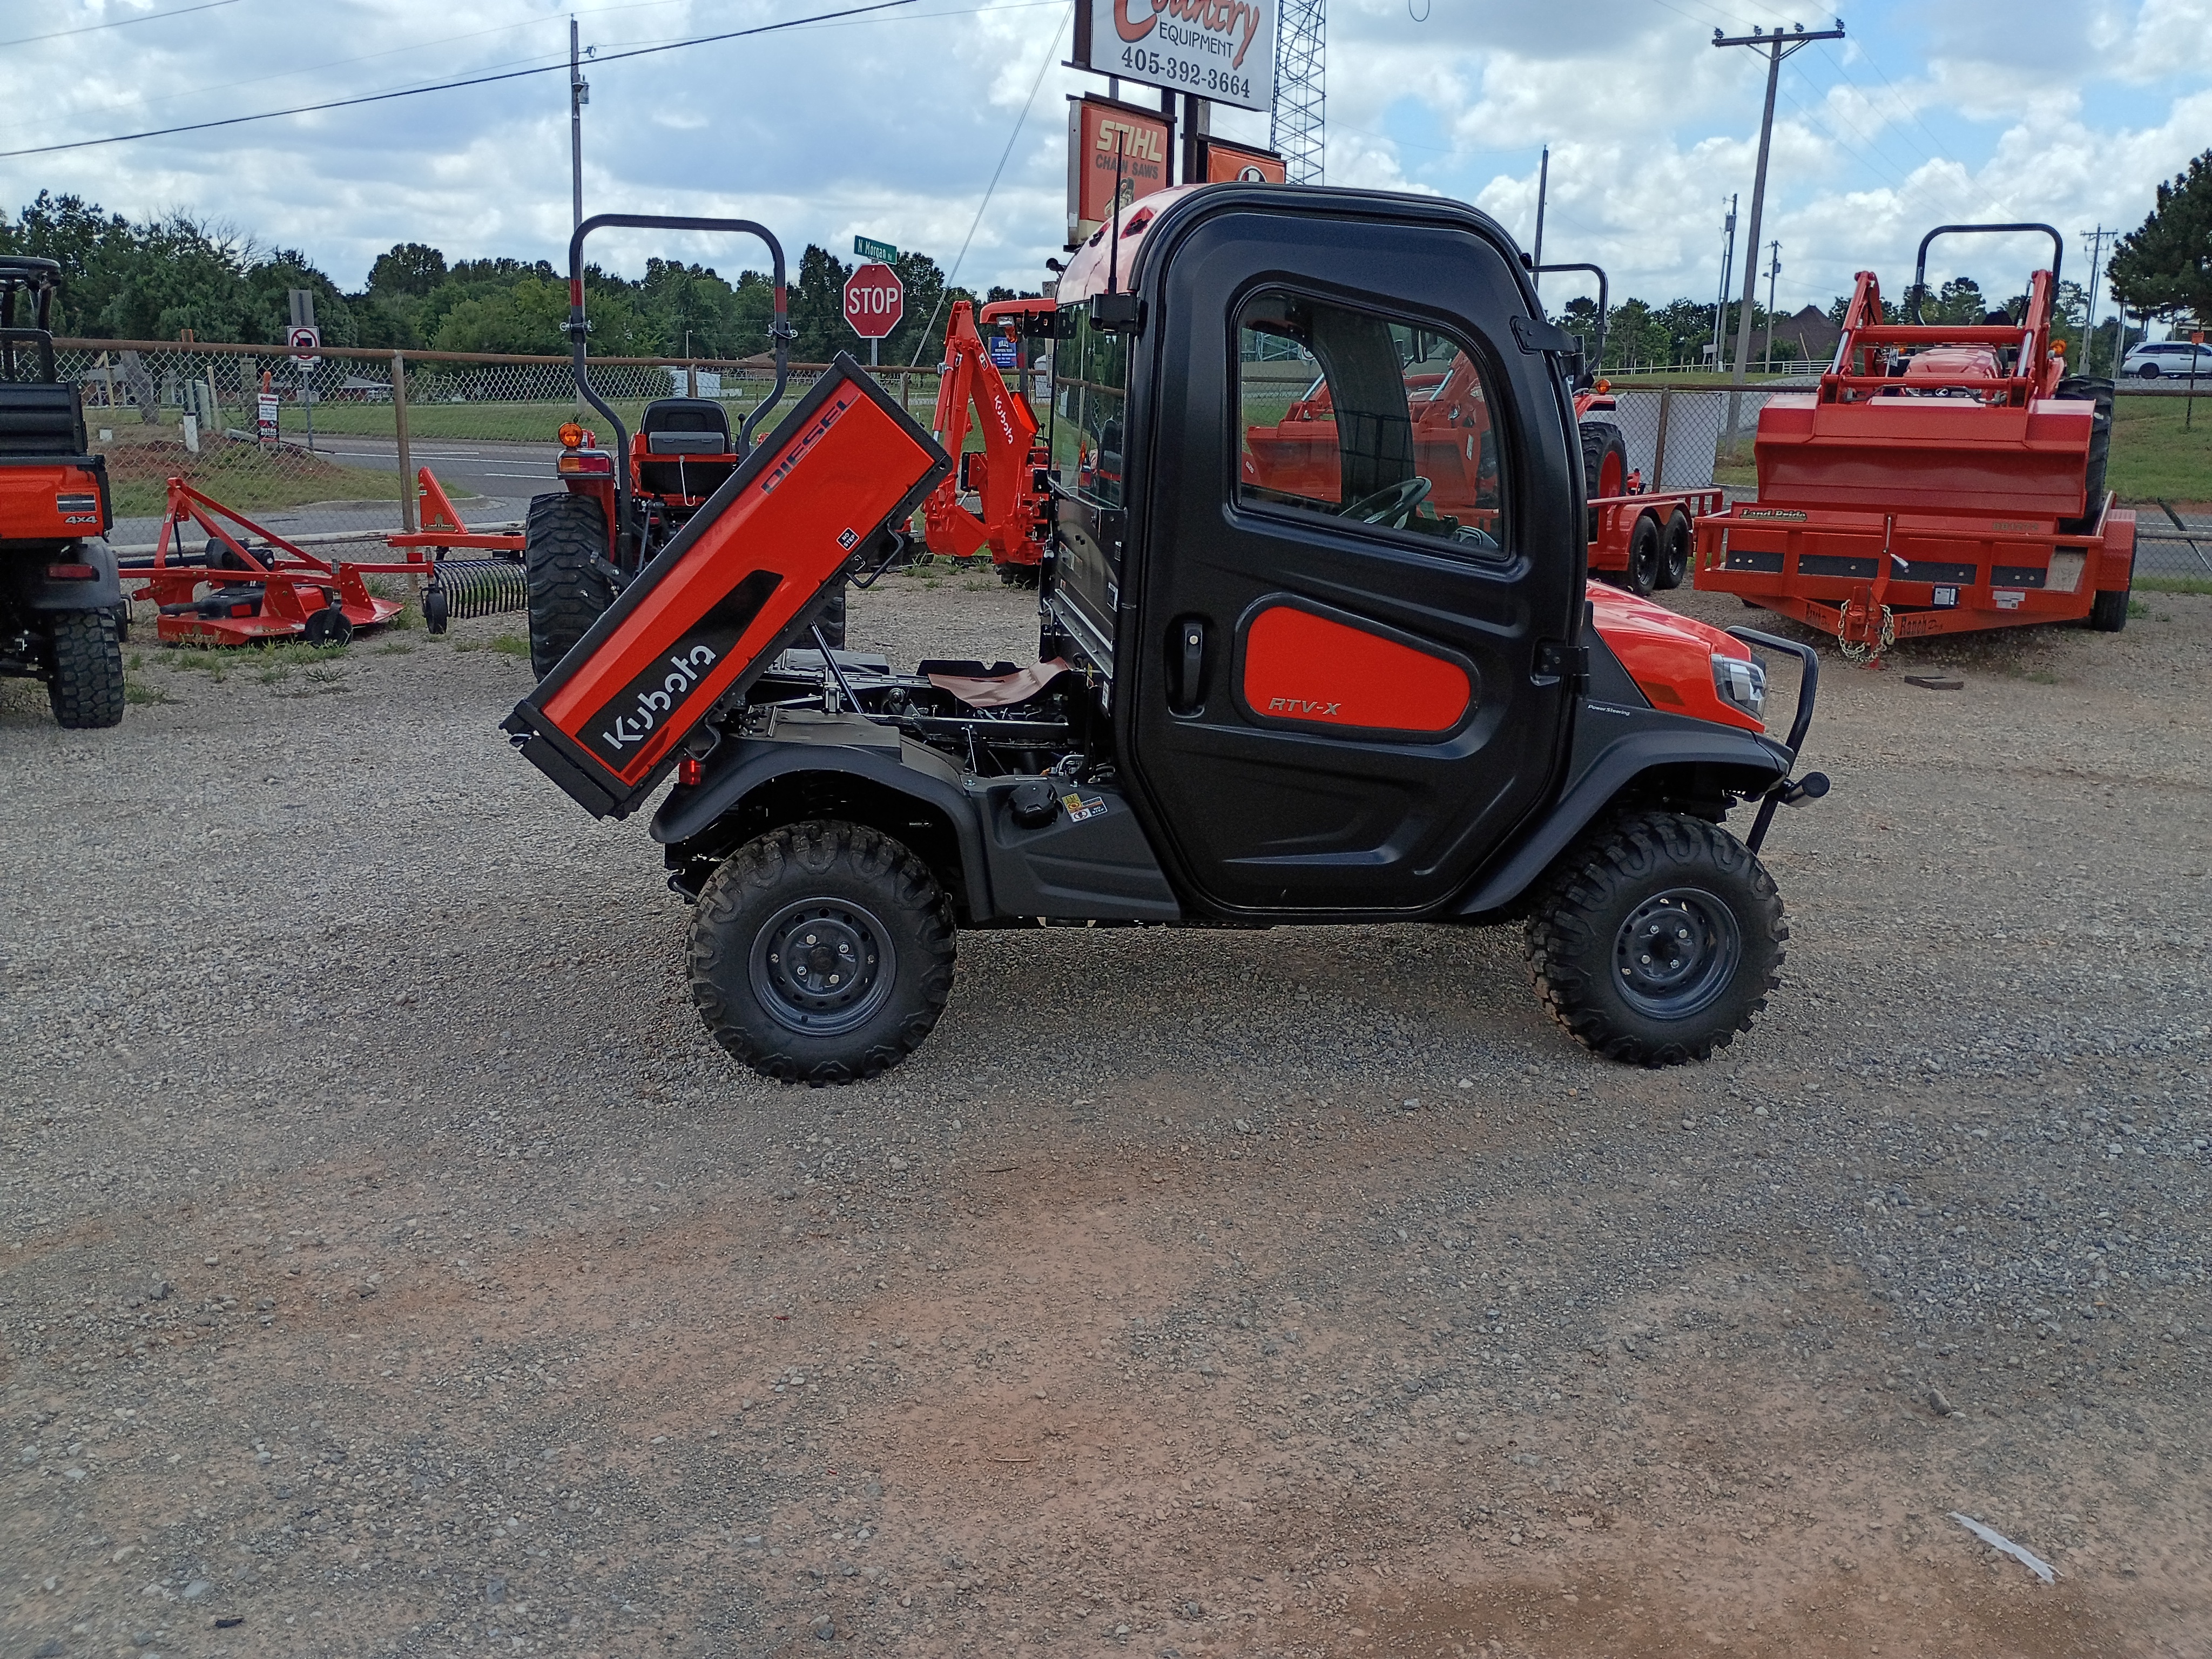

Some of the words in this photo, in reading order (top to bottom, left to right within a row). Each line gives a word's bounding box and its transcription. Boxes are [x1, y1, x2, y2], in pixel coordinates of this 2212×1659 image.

[1159, 22, 1233, 58] EQUIPMENT
[1121, 46, 1250, 98] 405-392-3664
[1096, 119, 1162, 162] STIHL
[1096, 153, 1129, 173] CHAN
[1132, 163, 1158, 180] SAWS
[858, 239, 863, 253] N
[865, 240, 886, 259] Morgan
[848, 287, 898, 314] STOP
[994, 395, 1013, 444] Kubota
[760, 393, 861, 495] DIESEL
[842, 532, 849, 541] NO
[844, 534, 855, 547] STEP
[602, 645, 717, 750] Kubota
[1269, 698, 1341, 716] RTV-X
